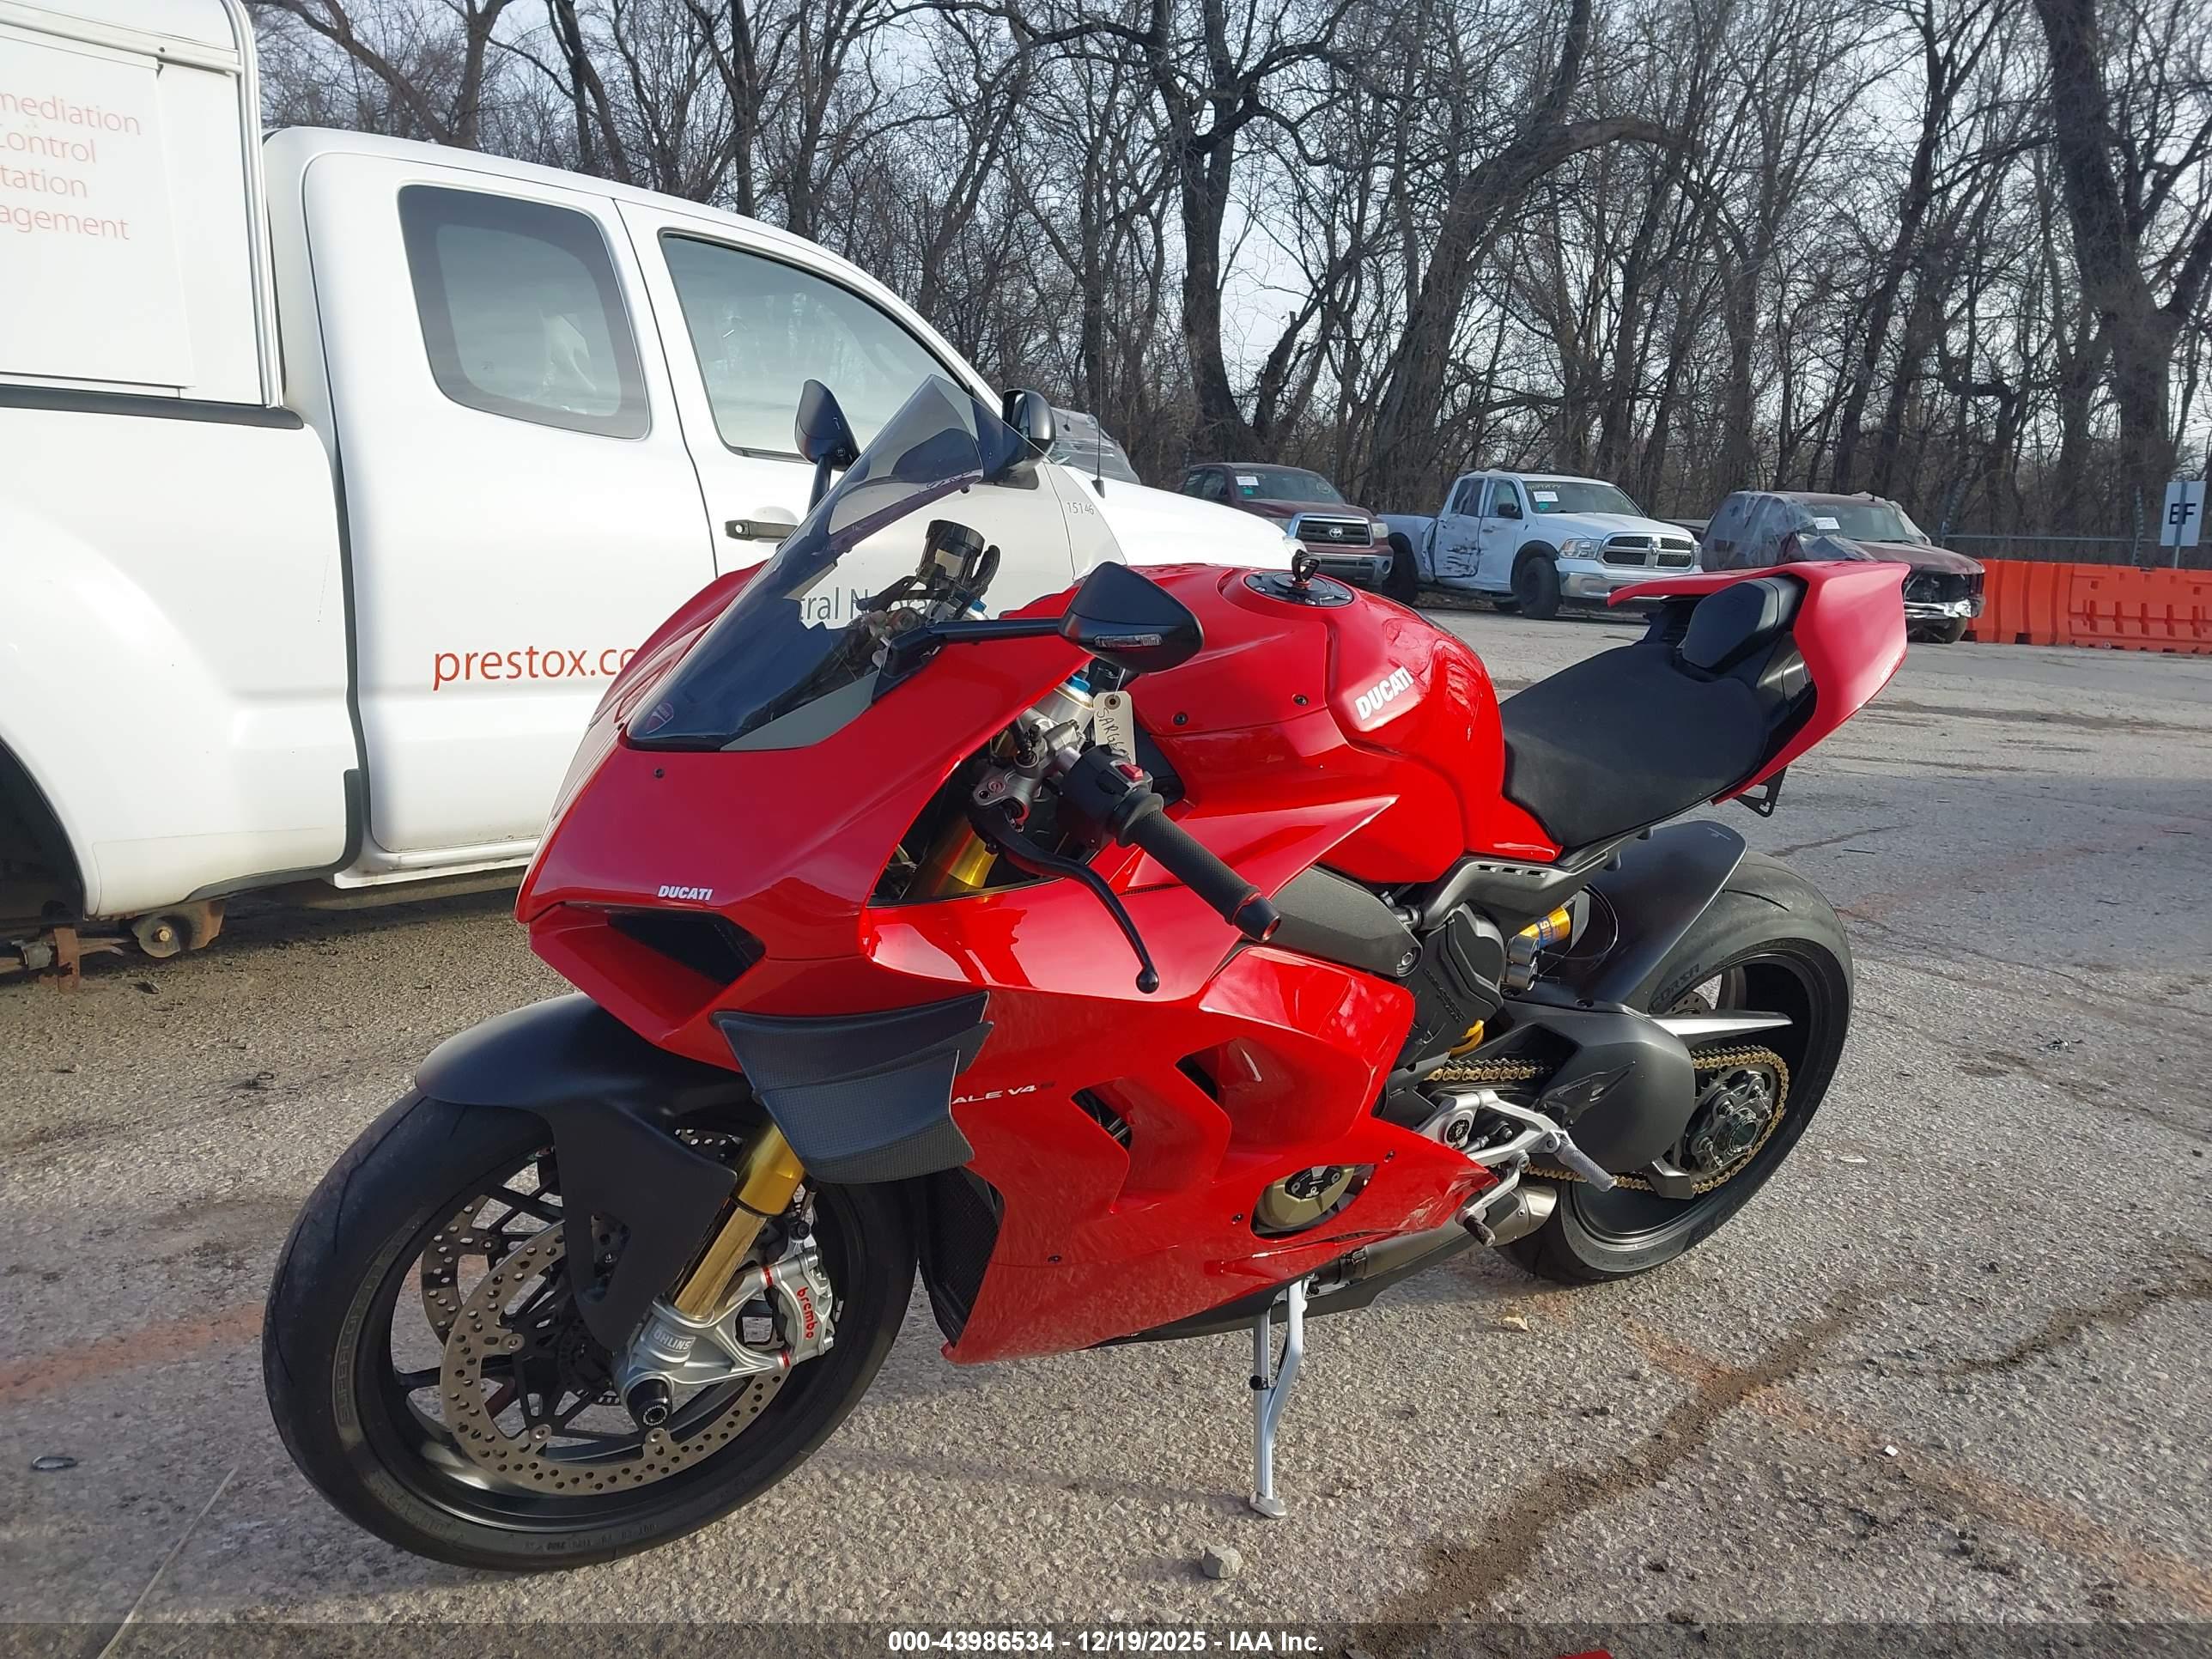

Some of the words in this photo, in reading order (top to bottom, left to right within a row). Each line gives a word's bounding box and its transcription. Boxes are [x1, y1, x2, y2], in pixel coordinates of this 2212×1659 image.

[0, 125, 96, 163] ontrol
[1066, 501, 1095, 516] 15146
[2168, 502, 2197, 526] EF
[1354, 665, 1414, 721] DUCATI
[657, 885, 714, 901] DUCATI
[951, 1090, 1004, 1105] ALE
[1008, 1085, 1037, 1096] V4
[796, 1286, 818, 1339] brembo
